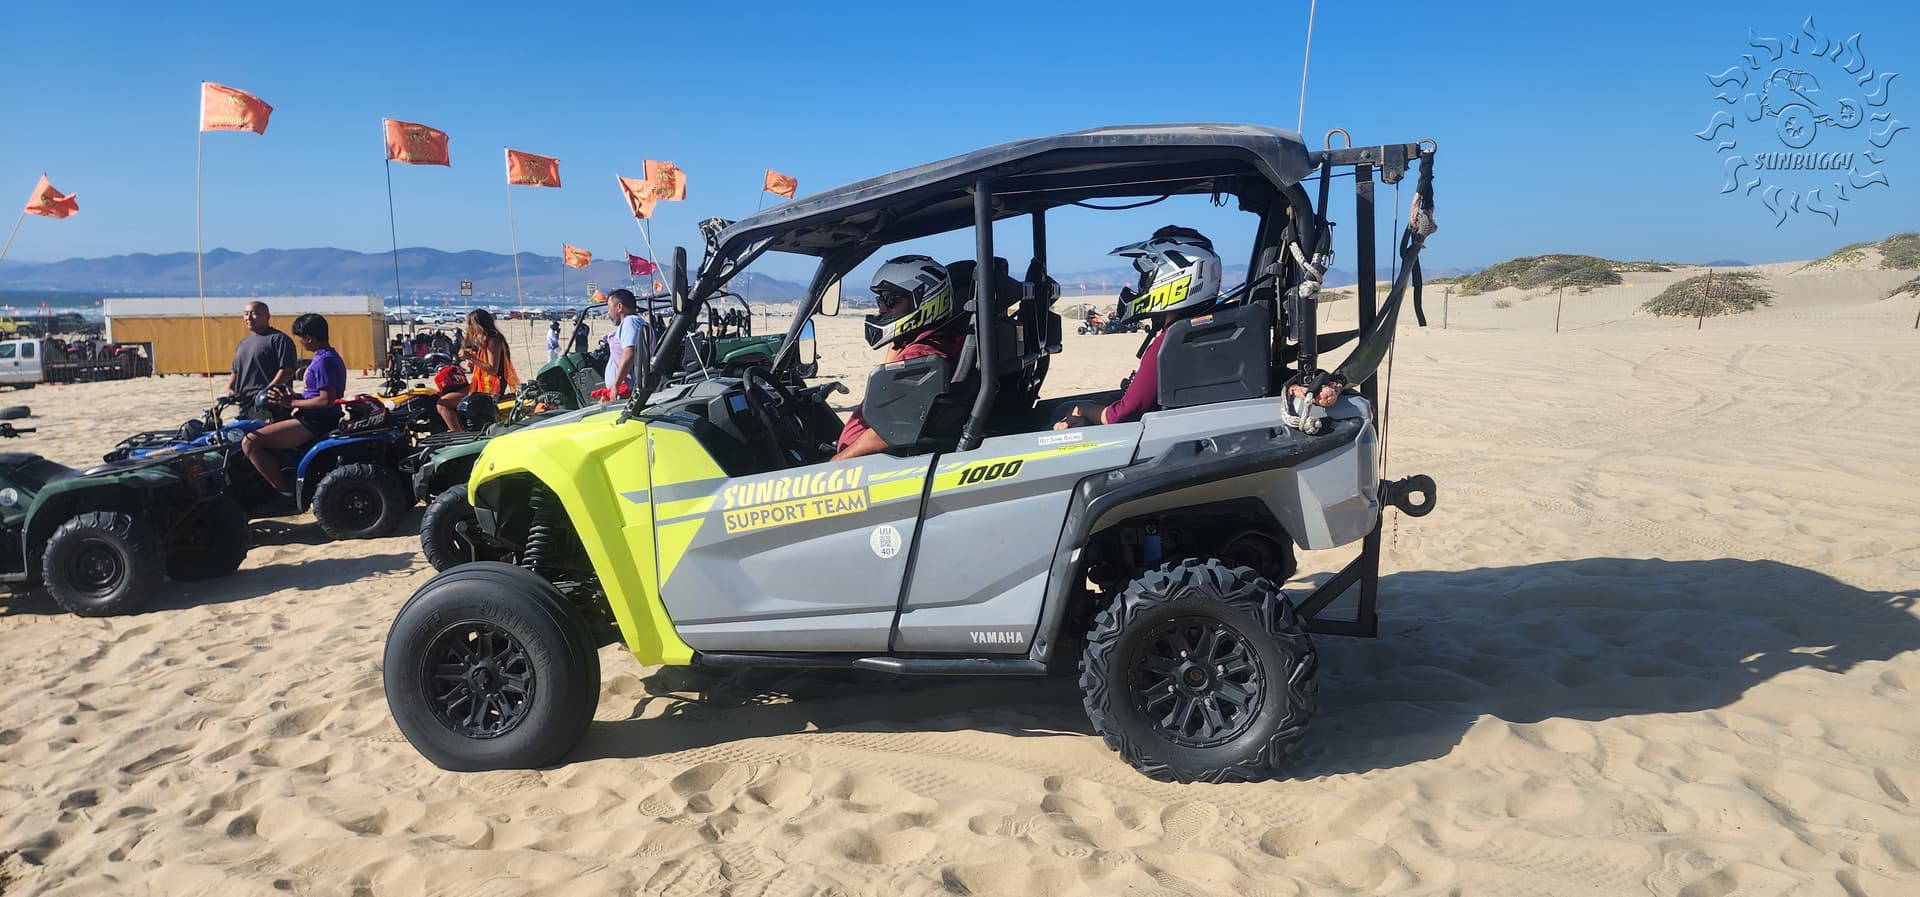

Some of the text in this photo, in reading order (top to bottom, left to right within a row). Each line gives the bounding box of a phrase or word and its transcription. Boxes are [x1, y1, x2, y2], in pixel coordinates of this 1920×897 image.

[723, 466, 864, 510] SUNBUGGY
[958, 460, 1024, 486] 1000
[726, 493, 865, 531] SUPPORT TEAM
[969, 631, 1024, 644] YAMAHA
